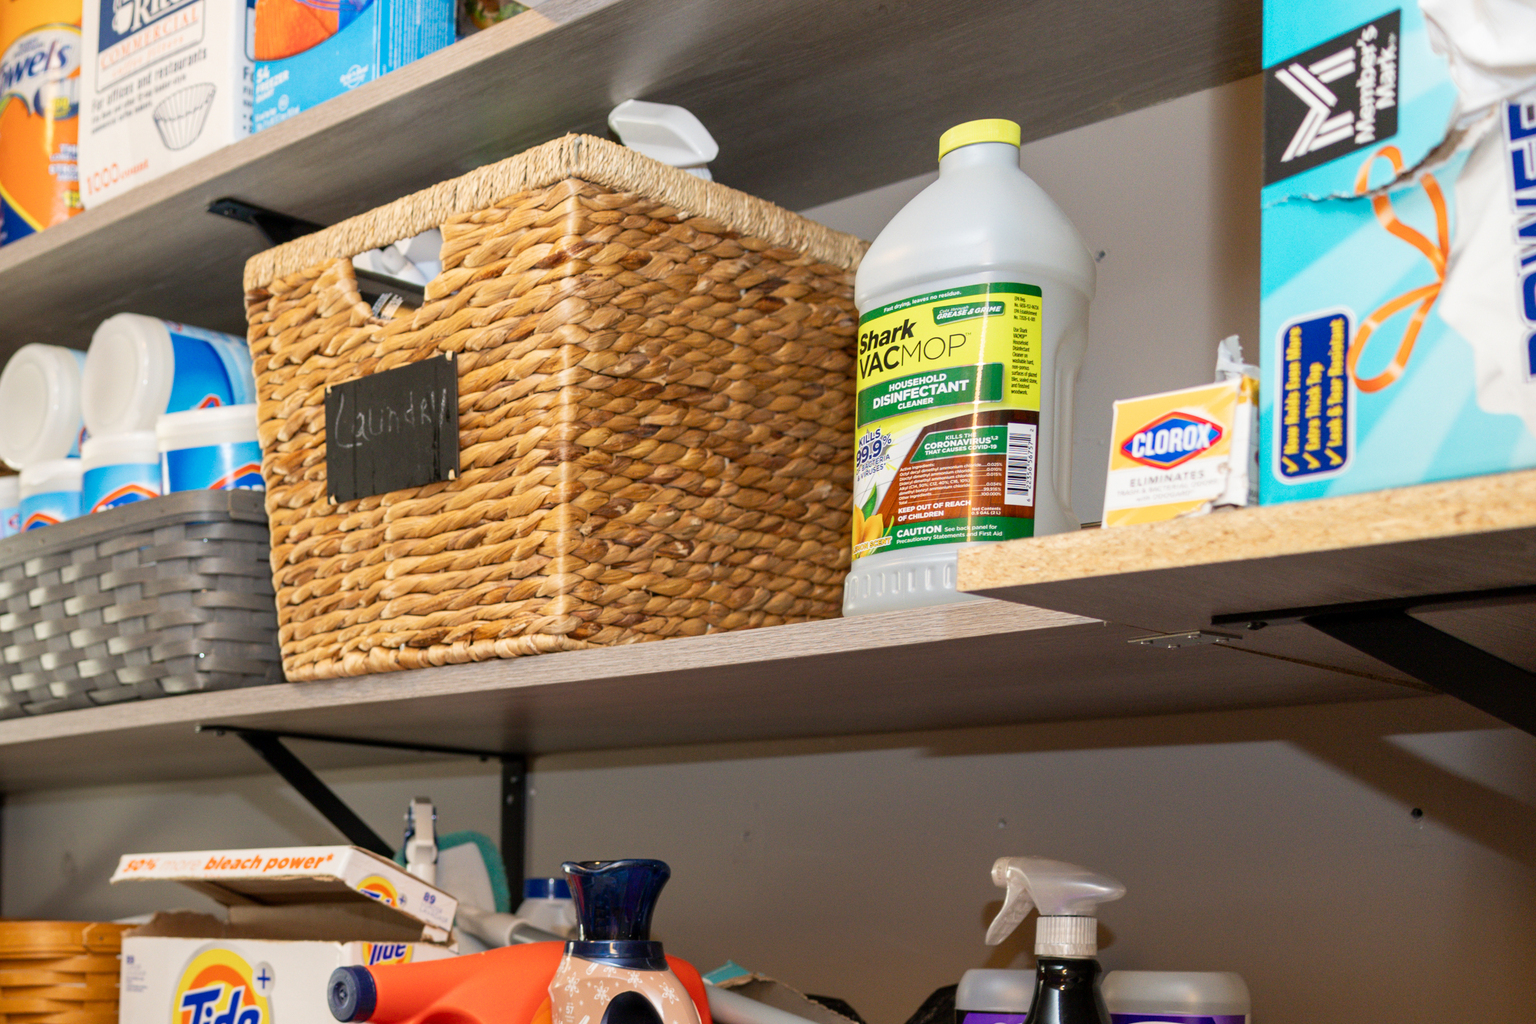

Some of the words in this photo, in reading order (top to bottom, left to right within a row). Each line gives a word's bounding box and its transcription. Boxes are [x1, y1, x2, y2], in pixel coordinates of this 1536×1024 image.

[100, 5, 200, 70] COMMERCIAL
[155, 47, 207, 79] restaurants
[1353, 25, 1378, 144] Member's
[1375, 46, 1398, 110] Mark
[86, 162, 119, 195] 1000
[894, 300, 912, 311] drying,
[912, 296, 929, 304] leaves
[938, 290, 962, 299] residue.
[936, 309, 967, 320] GREASE
[974, 305, 1002, 314] GRIME
[859, 318, 917, 355] Shark
[888, 373, 948, 392] HOUSEHOLD
[872, 379, 970, 410] DISINFECTANT
[897, 397, 934, 410] CLEANER
[858, 428, 880, 448] KILLS
[1131, 422, 1214, 458] CLOROX
[862, 454, 890, 472] BACTERIA
[1130, 469, 1205, 488] ELIMINATES
[898, 505, 916, 514] KEEP
[945, 500, 971, 508] REACH
[908, 510, 944, 520] CHILDREN
[896, 525, 942, 538] CAUTION
[896, 535, 932, 544] Precautionary
[869, 536, 892, 548] SCENT
[204, 854, 261, 872] bleach
[423, 891, 436, 905] 89
[565, 1005, 574, 1014] 57
